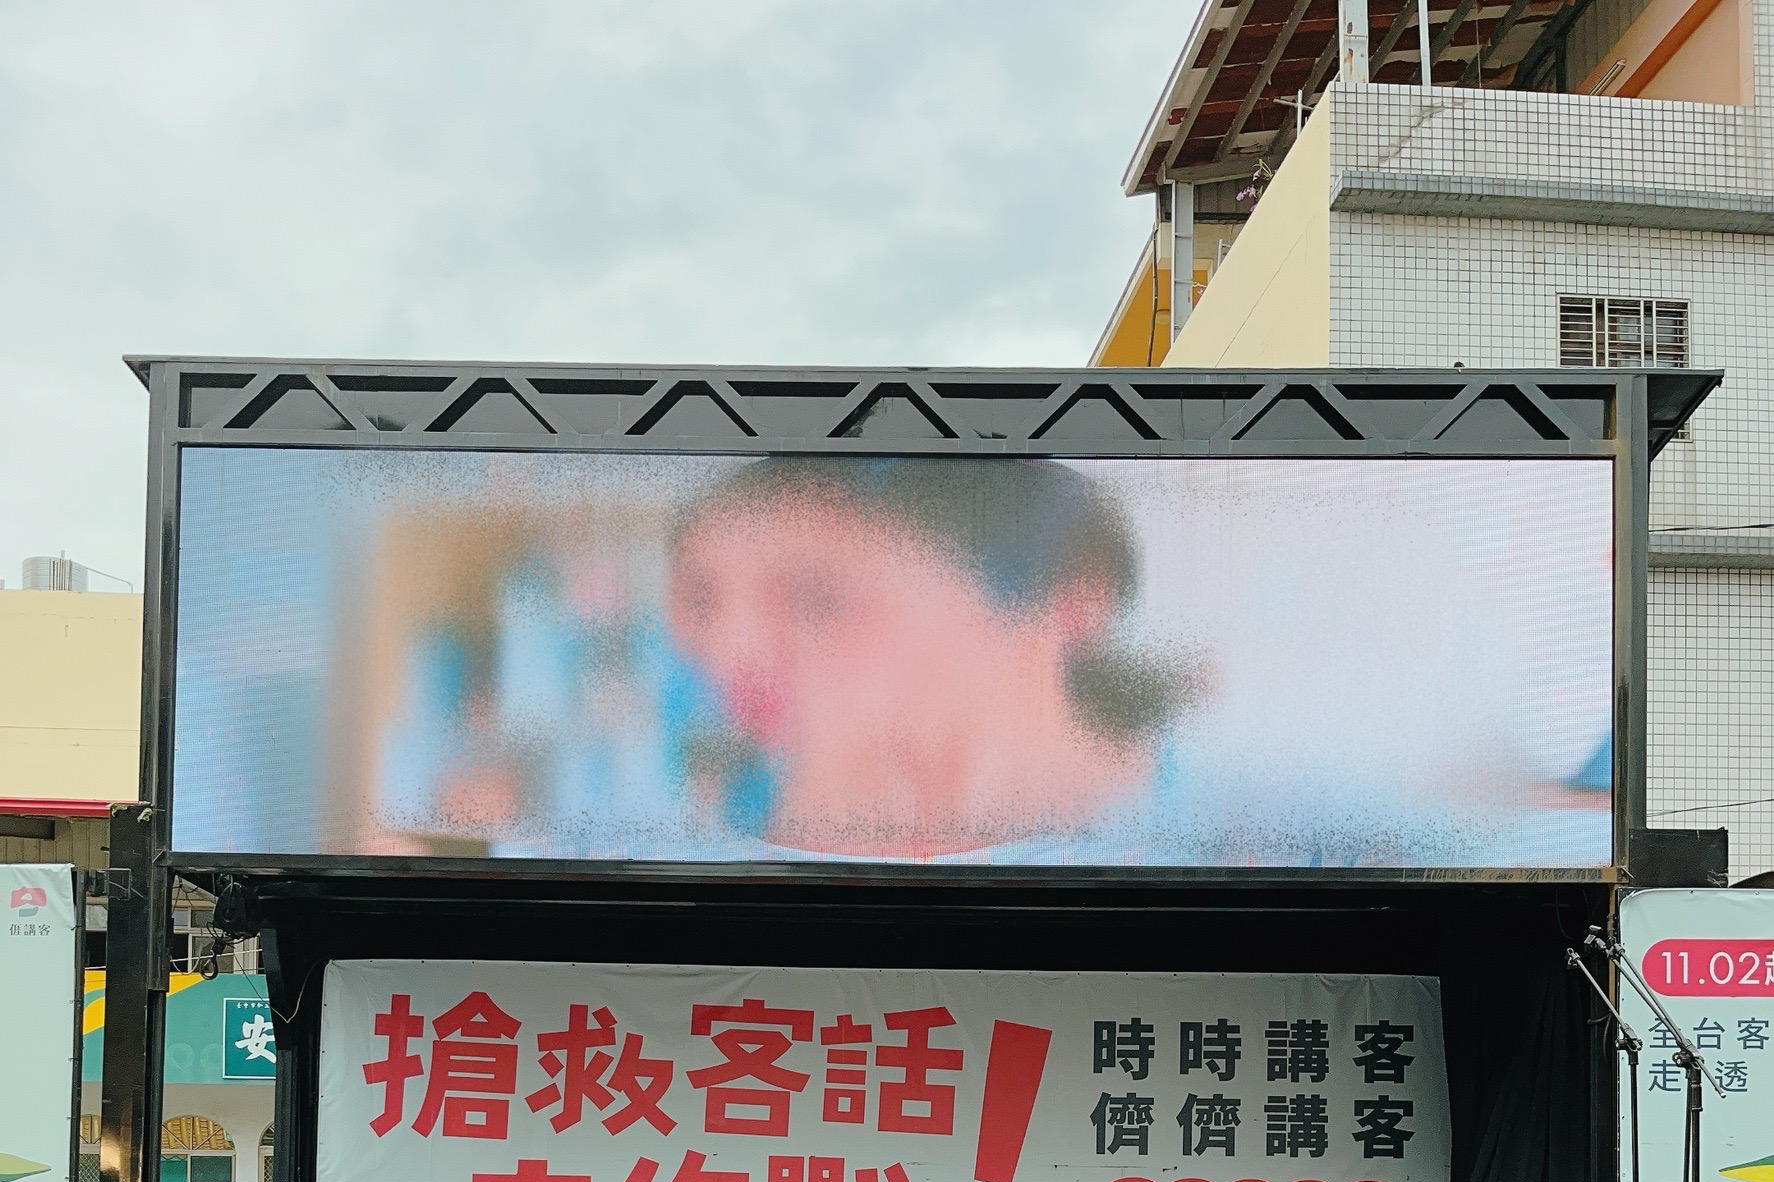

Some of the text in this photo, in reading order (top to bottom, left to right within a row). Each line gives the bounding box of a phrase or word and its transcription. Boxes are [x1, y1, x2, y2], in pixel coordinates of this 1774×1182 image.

[362, 990, 965, 1140] 搶救客話
[1093, 1017, 1415, 1084] 時時講客
[1089, 1092, 1415, 1159] 儕儕講客
